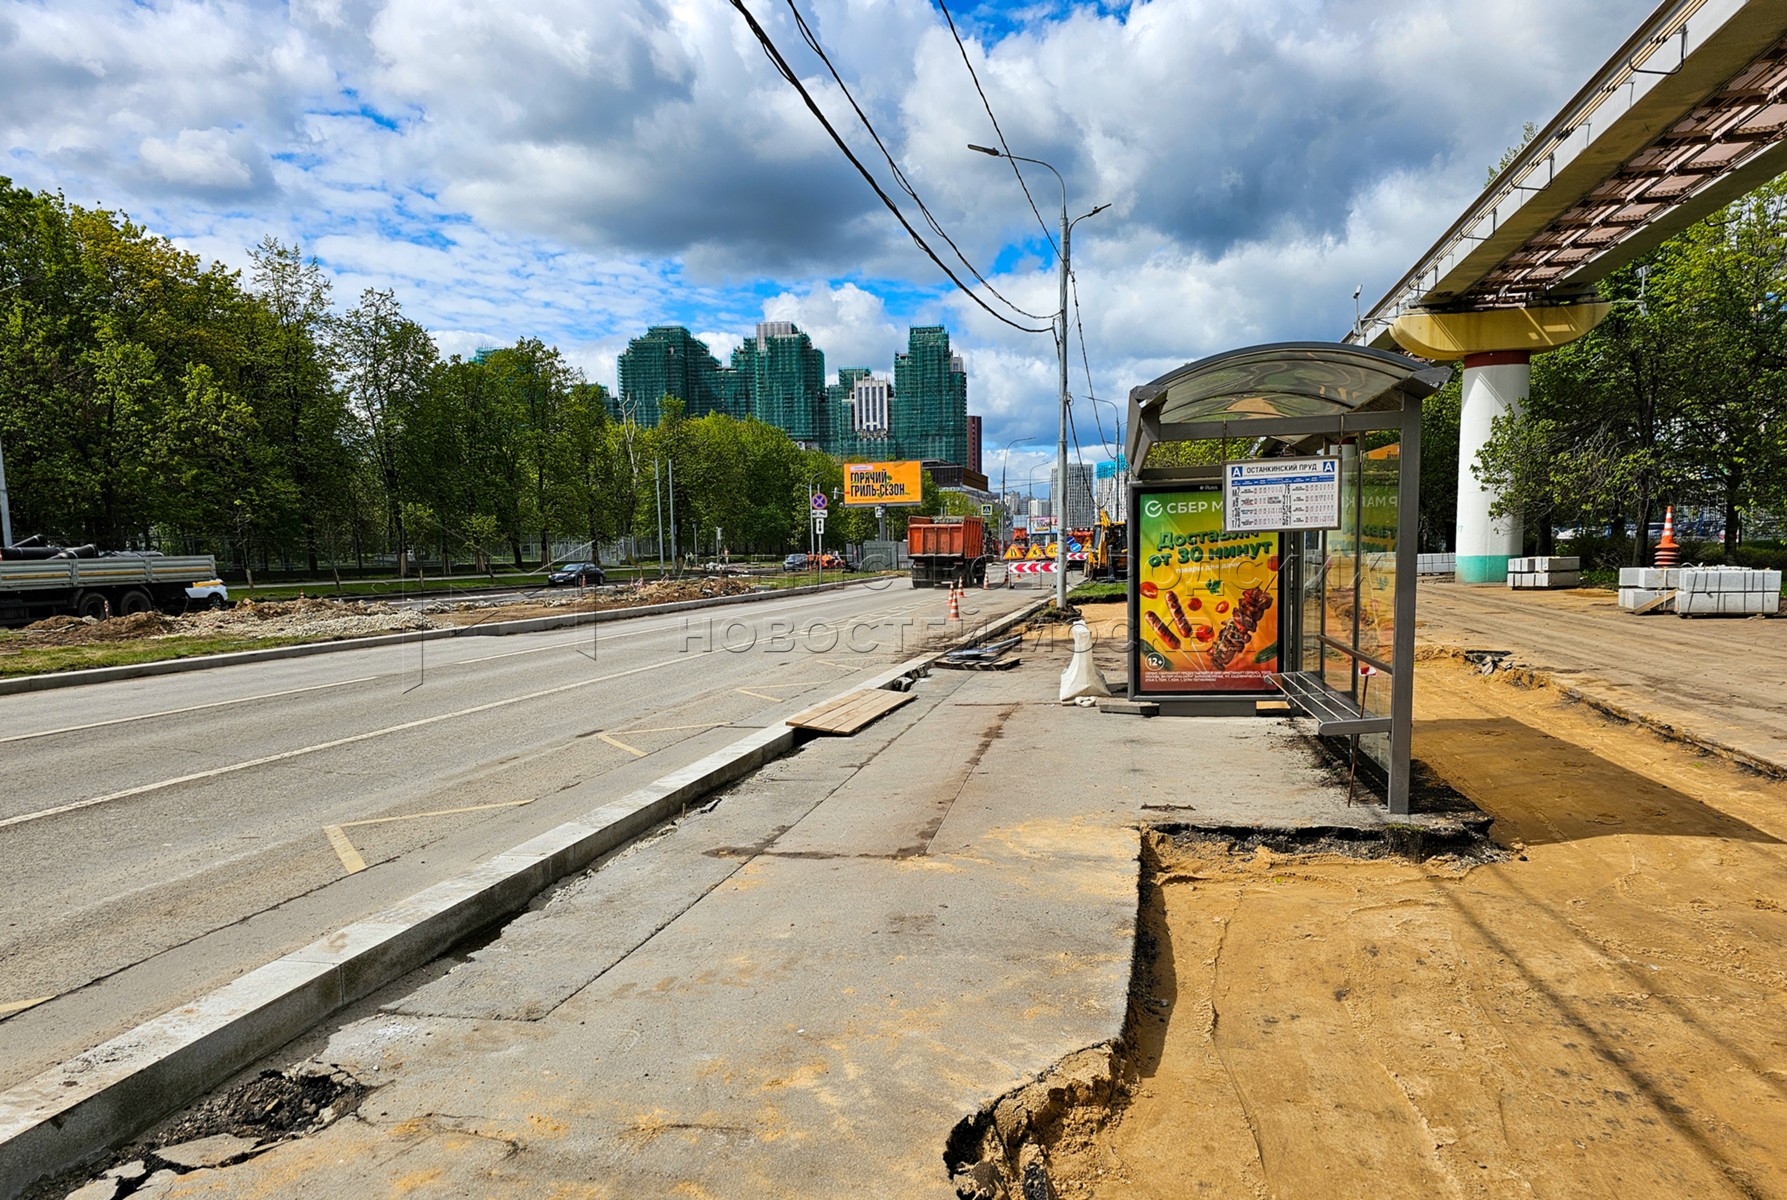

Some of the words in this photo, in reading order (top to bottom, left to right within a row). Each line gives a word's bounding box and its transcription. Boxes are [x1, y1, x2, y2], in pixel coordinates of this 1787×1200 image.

[851, 469, 887, 484] ГОРЯЧИЙ
[1233, 467, 1241, 477] А
[1246, 464, 1298, 474] ОСТАНКИНСКИЙ
[1299, 463, 1317, 471] ПРУД
[1324, 462, 1333, 472] А
[851, 483, 905, 497] ГРИЛЬ-СЕЗОН
[1167, 502, 1207, 514] СБЕР
[1149, 553, 1172, 568] от
[1178, 546, 1204, 564] 30
[1208, 541, 1273, 561] минут
[1148, 658, 1163, 666] 12+
